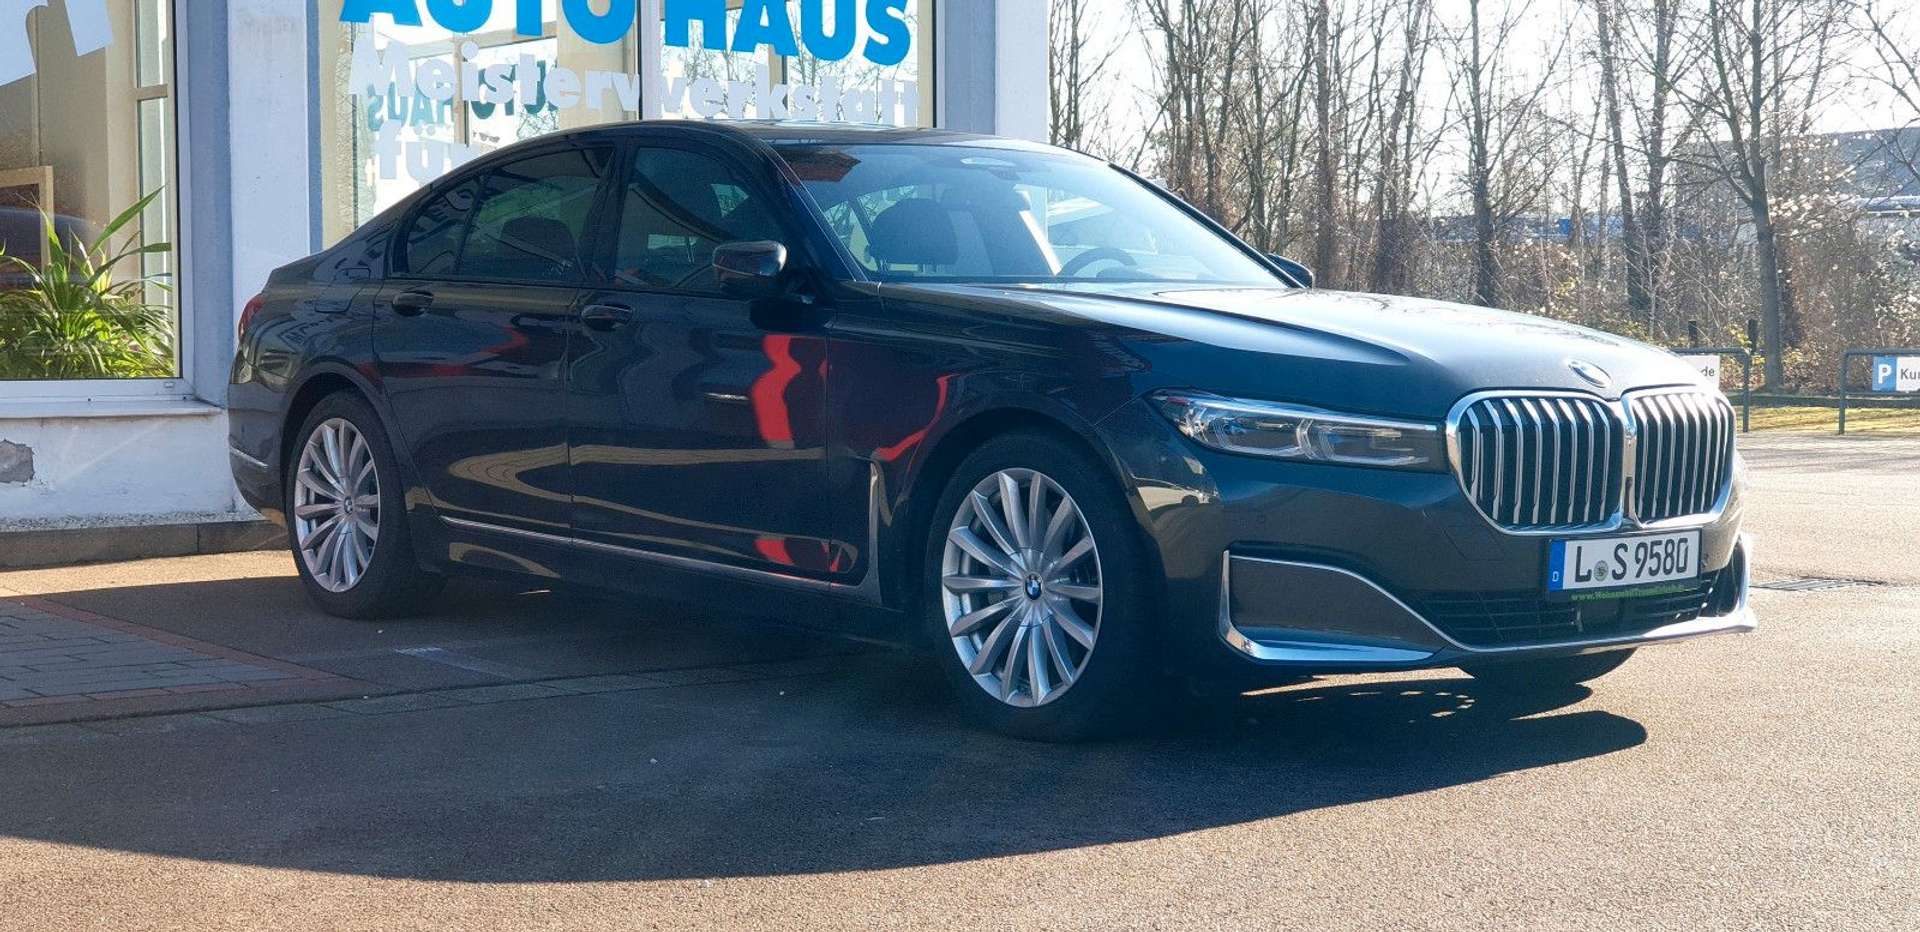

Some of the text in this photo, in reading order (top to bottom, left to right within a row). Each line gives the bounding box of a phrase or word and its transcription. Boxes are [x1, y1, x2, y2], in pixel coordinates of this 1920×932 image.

[665, 0, 911, 66] HAUS
[1878, 364, 1892, 384] P
[1575, 538, 1688, 582] L S 9580
